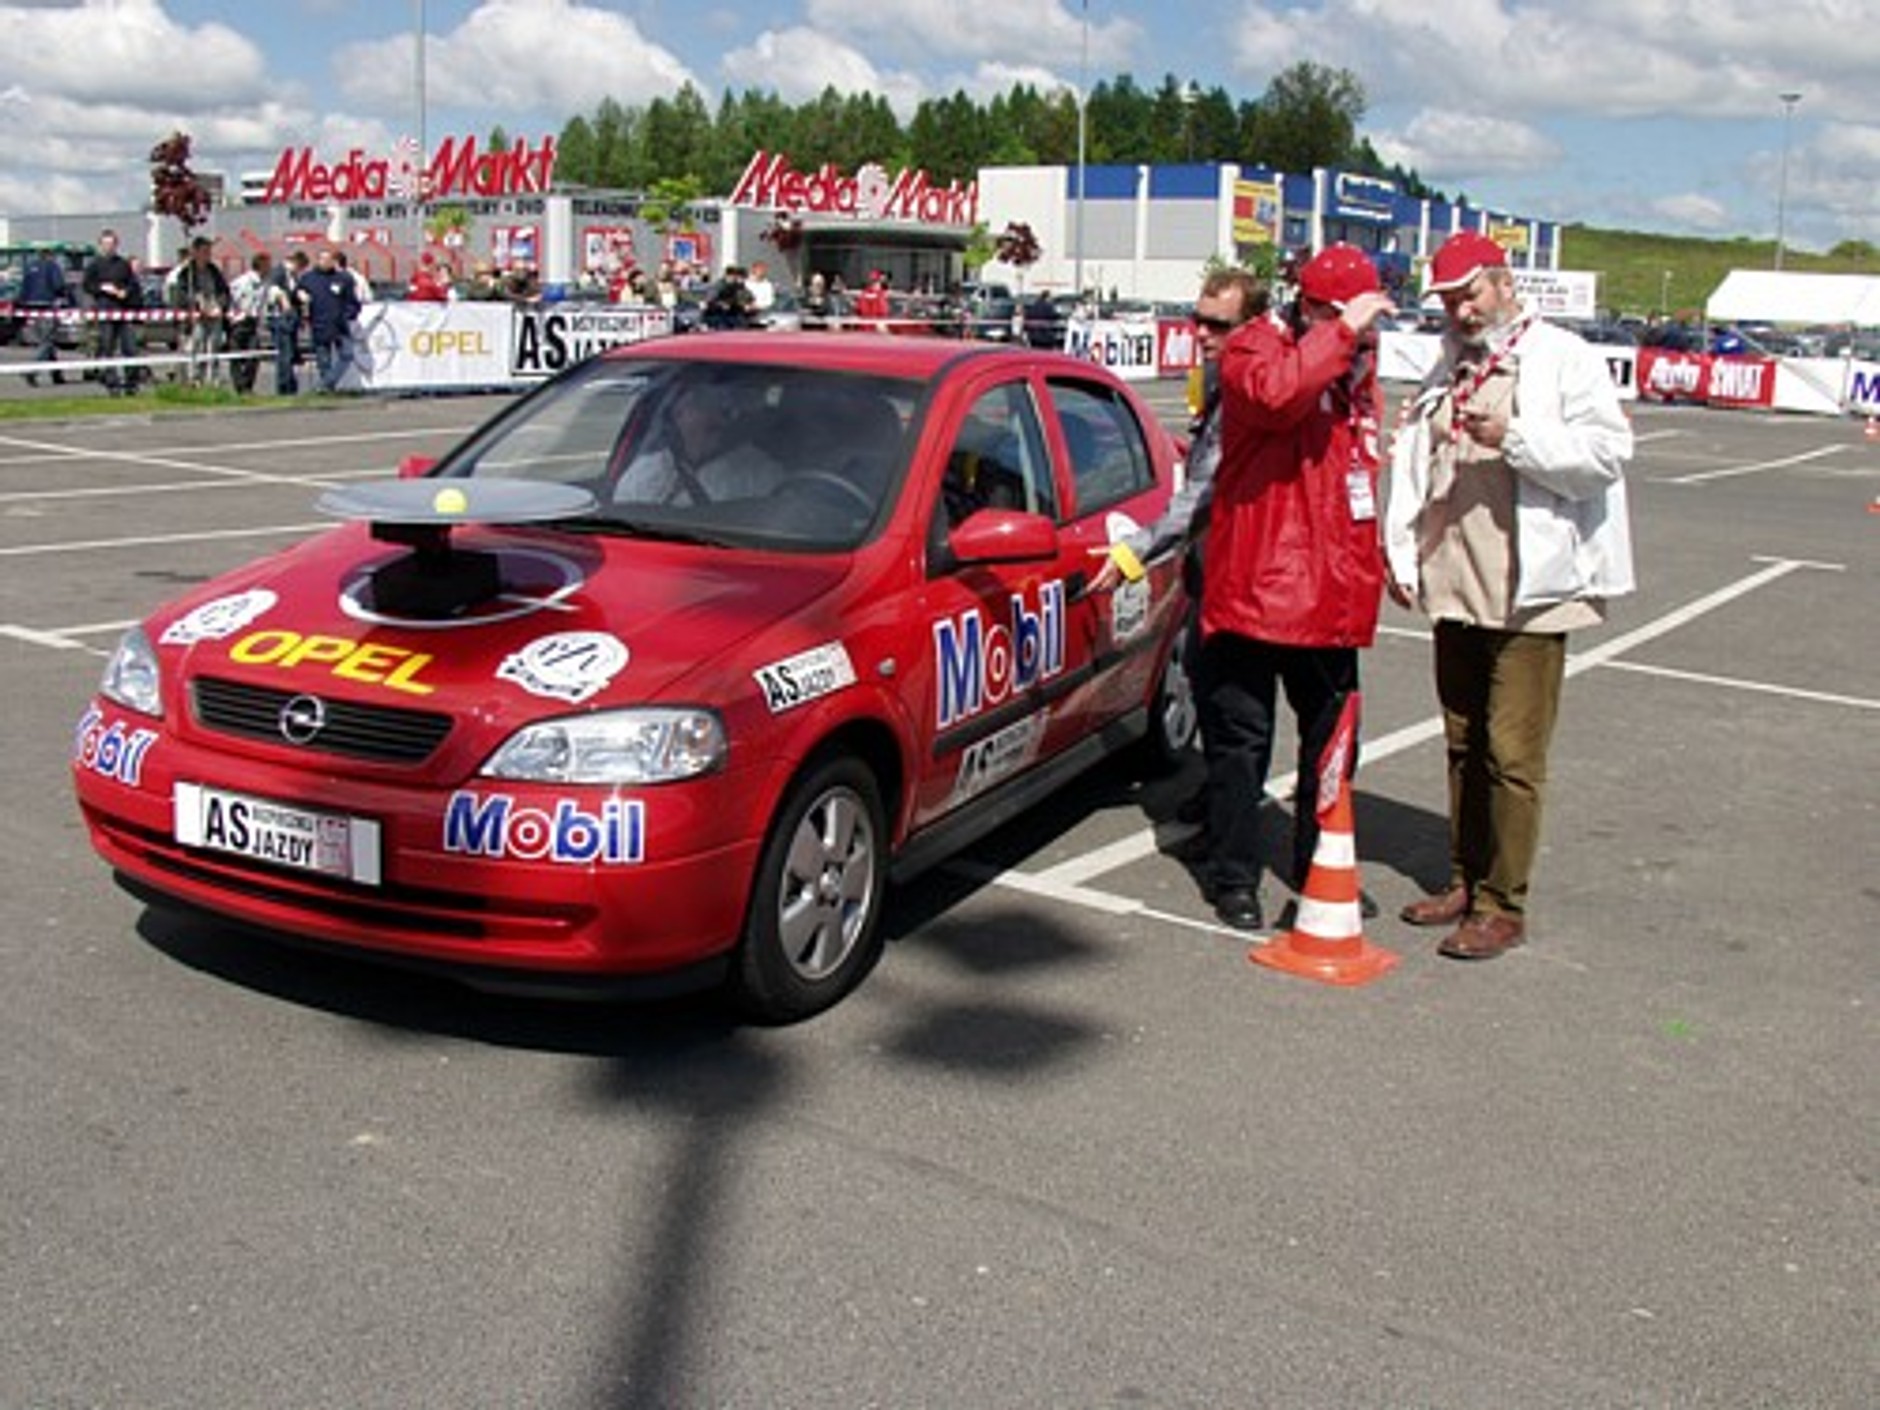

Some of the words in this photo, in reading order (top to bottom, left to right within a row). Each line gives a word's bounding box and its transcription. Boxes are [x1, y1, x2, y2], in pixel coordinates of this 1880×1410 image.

[262, 146, 389, 204] Media
[420, 135, 555, 203] Markt
[731, 149, 861, 213] Media
[883, 167, 979, 226] Markt
[410, 330, 491, 356] OPEL
[515, 315, 567, 370] AS
[1067, 329, 1134, 367] Mobil
[229, 629, 435, 694] OPEL
[762, 664, 800, 707] AS
[933, 578, 1066, 731] Mobil
[205, 797, 250, 850] AS
[252, 827, 314, 865] JAZDY
[444, 790, 645, 864] Mobil
